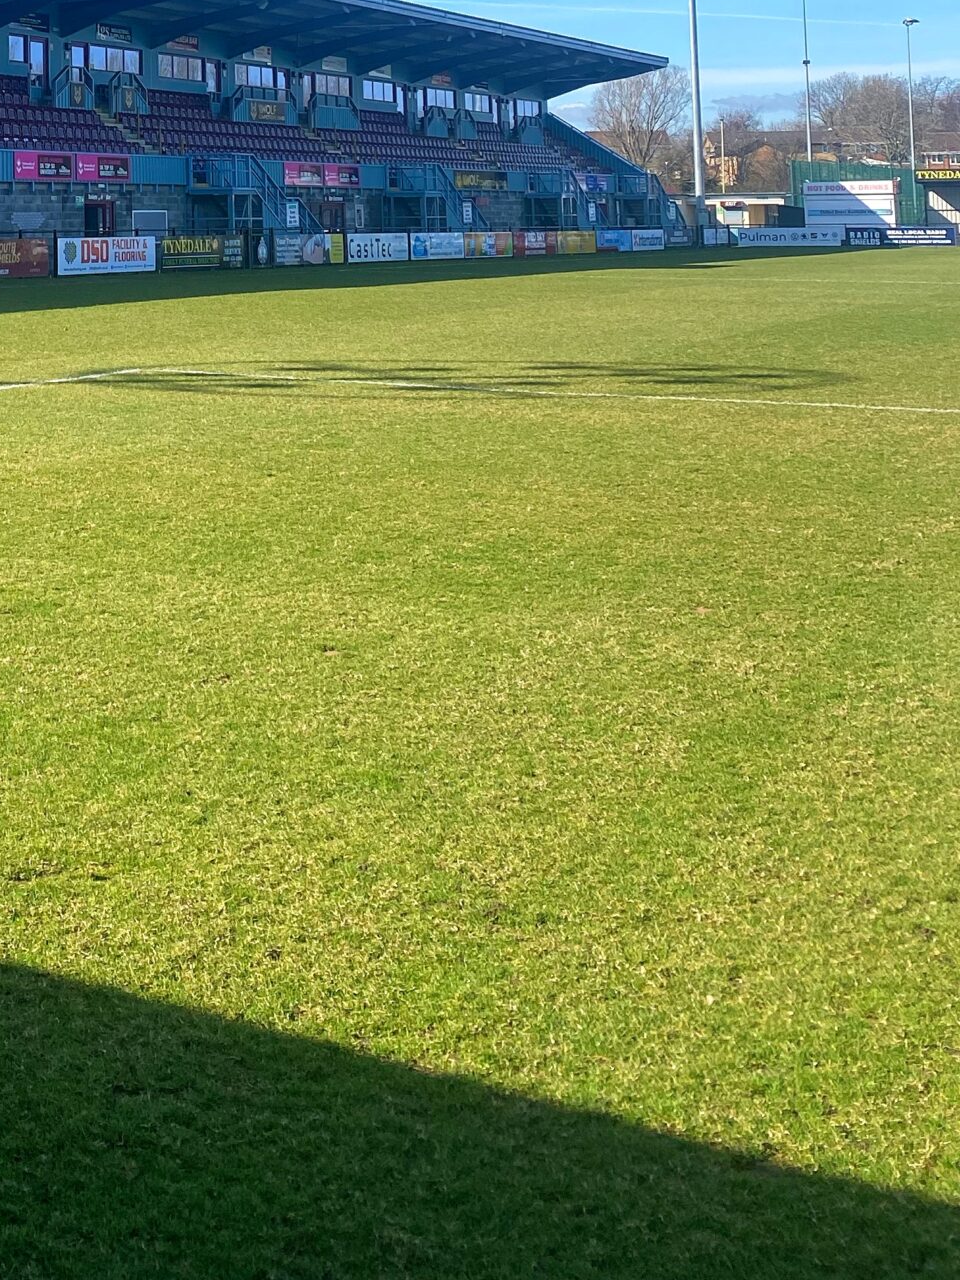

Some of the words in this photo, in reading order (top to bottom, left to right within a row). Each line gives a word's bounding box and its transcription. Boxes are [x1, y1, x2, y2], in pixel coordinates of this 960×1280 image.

[916, 171, 960, 180] TYNEDA
[740, 232, 787, 242] Pulman
[81, 239, 109, 263] DSO
[112, 239, 140, 249] FACILITY
[142, 238, 148, 249] &
[162, 239, 212, 254] TYNEDALE
[349, 238, 392, 259] CastTec
[114, 250, 146, 263] FLOORING
